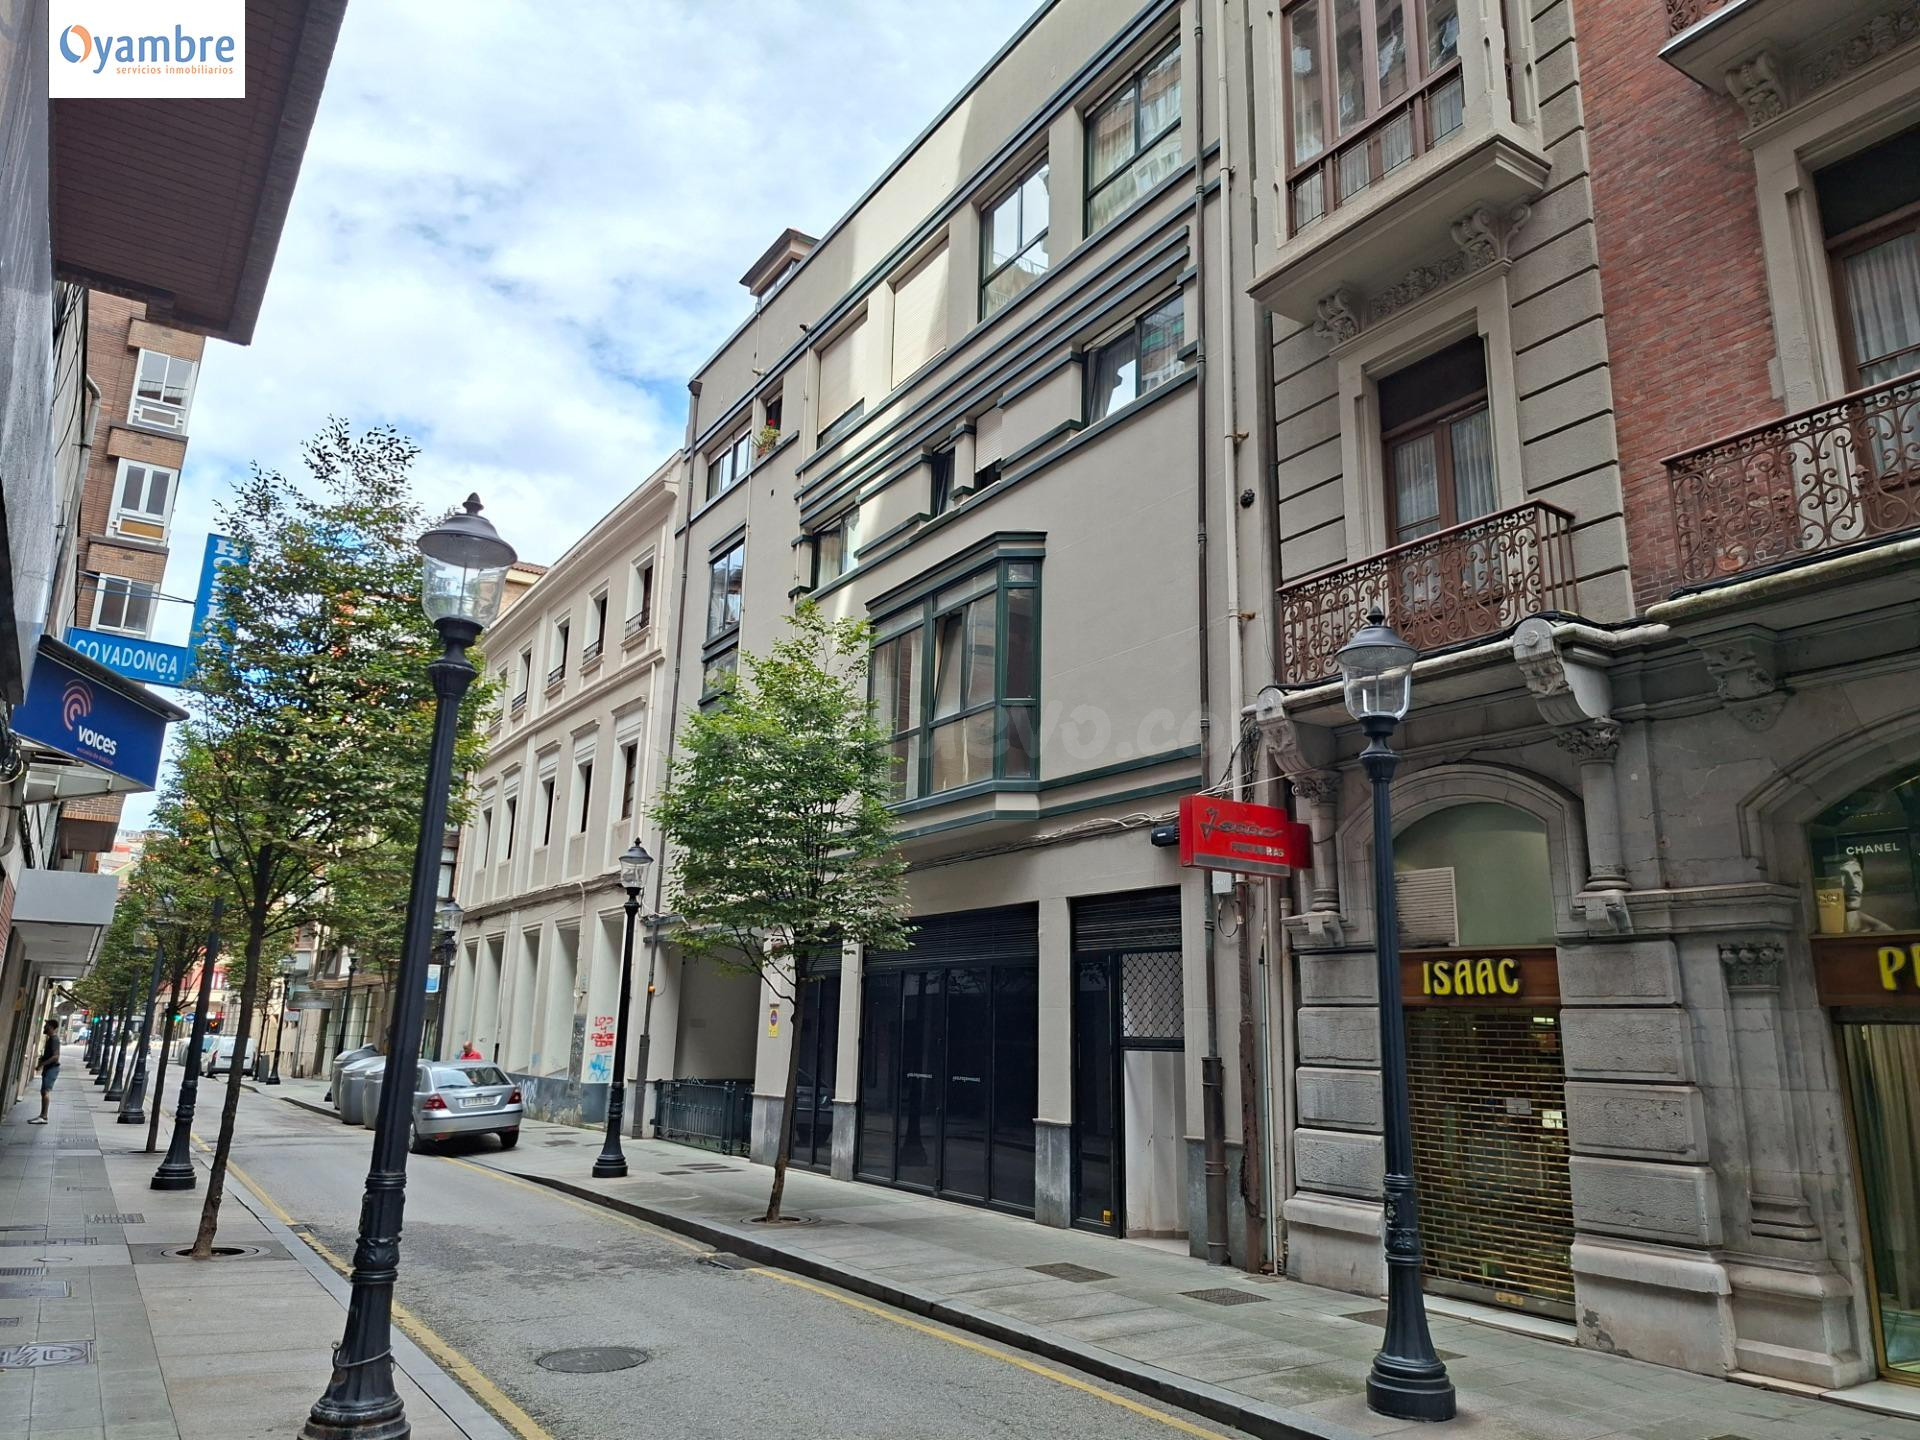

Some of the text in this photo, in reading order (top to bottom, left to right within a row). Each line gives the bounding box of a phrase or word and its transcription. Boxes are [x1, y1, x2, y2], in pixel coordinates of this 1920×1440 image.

[75, 640, 178, 675] COVADONGA
[1846, 843, 1901, 856] CHANEL
[1422, 958, 1520, 996] ISAAC
